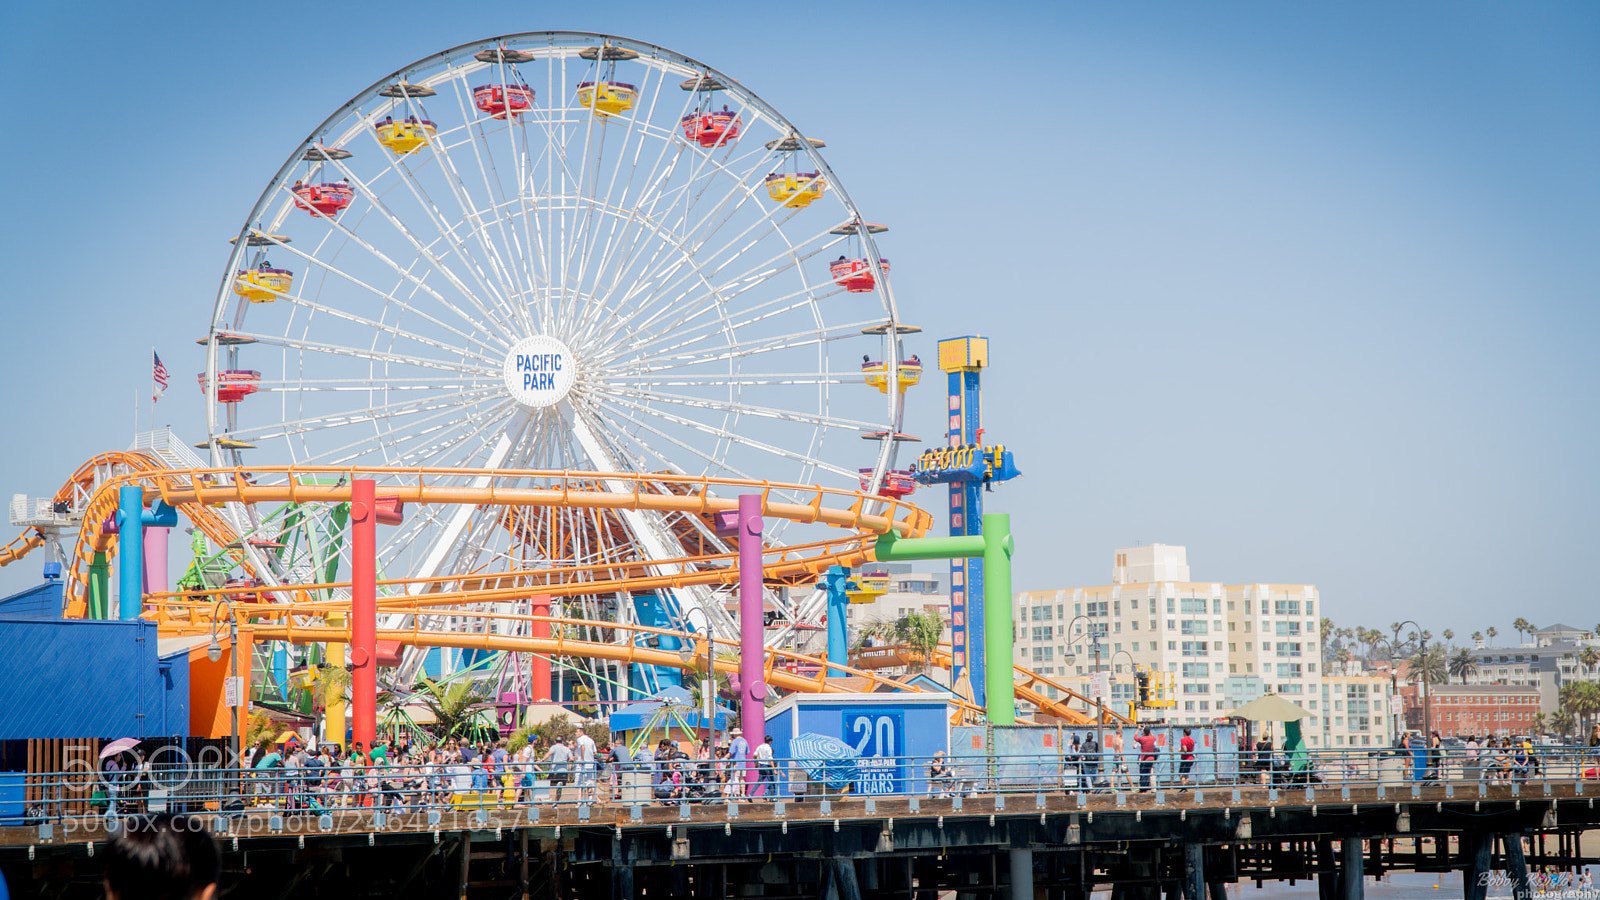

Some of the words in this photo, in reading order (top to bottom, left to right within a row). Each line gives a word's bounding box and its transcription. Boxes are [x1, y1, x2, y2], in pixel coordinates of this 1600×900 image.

[516, 353, 562, 372] PACIFIC
[944, 354, 963, 364] PARK
[523, 372, 555, 391] PARK
[853, 716, 895, 758] 20
[856, 773, 894, 793] YEARS
